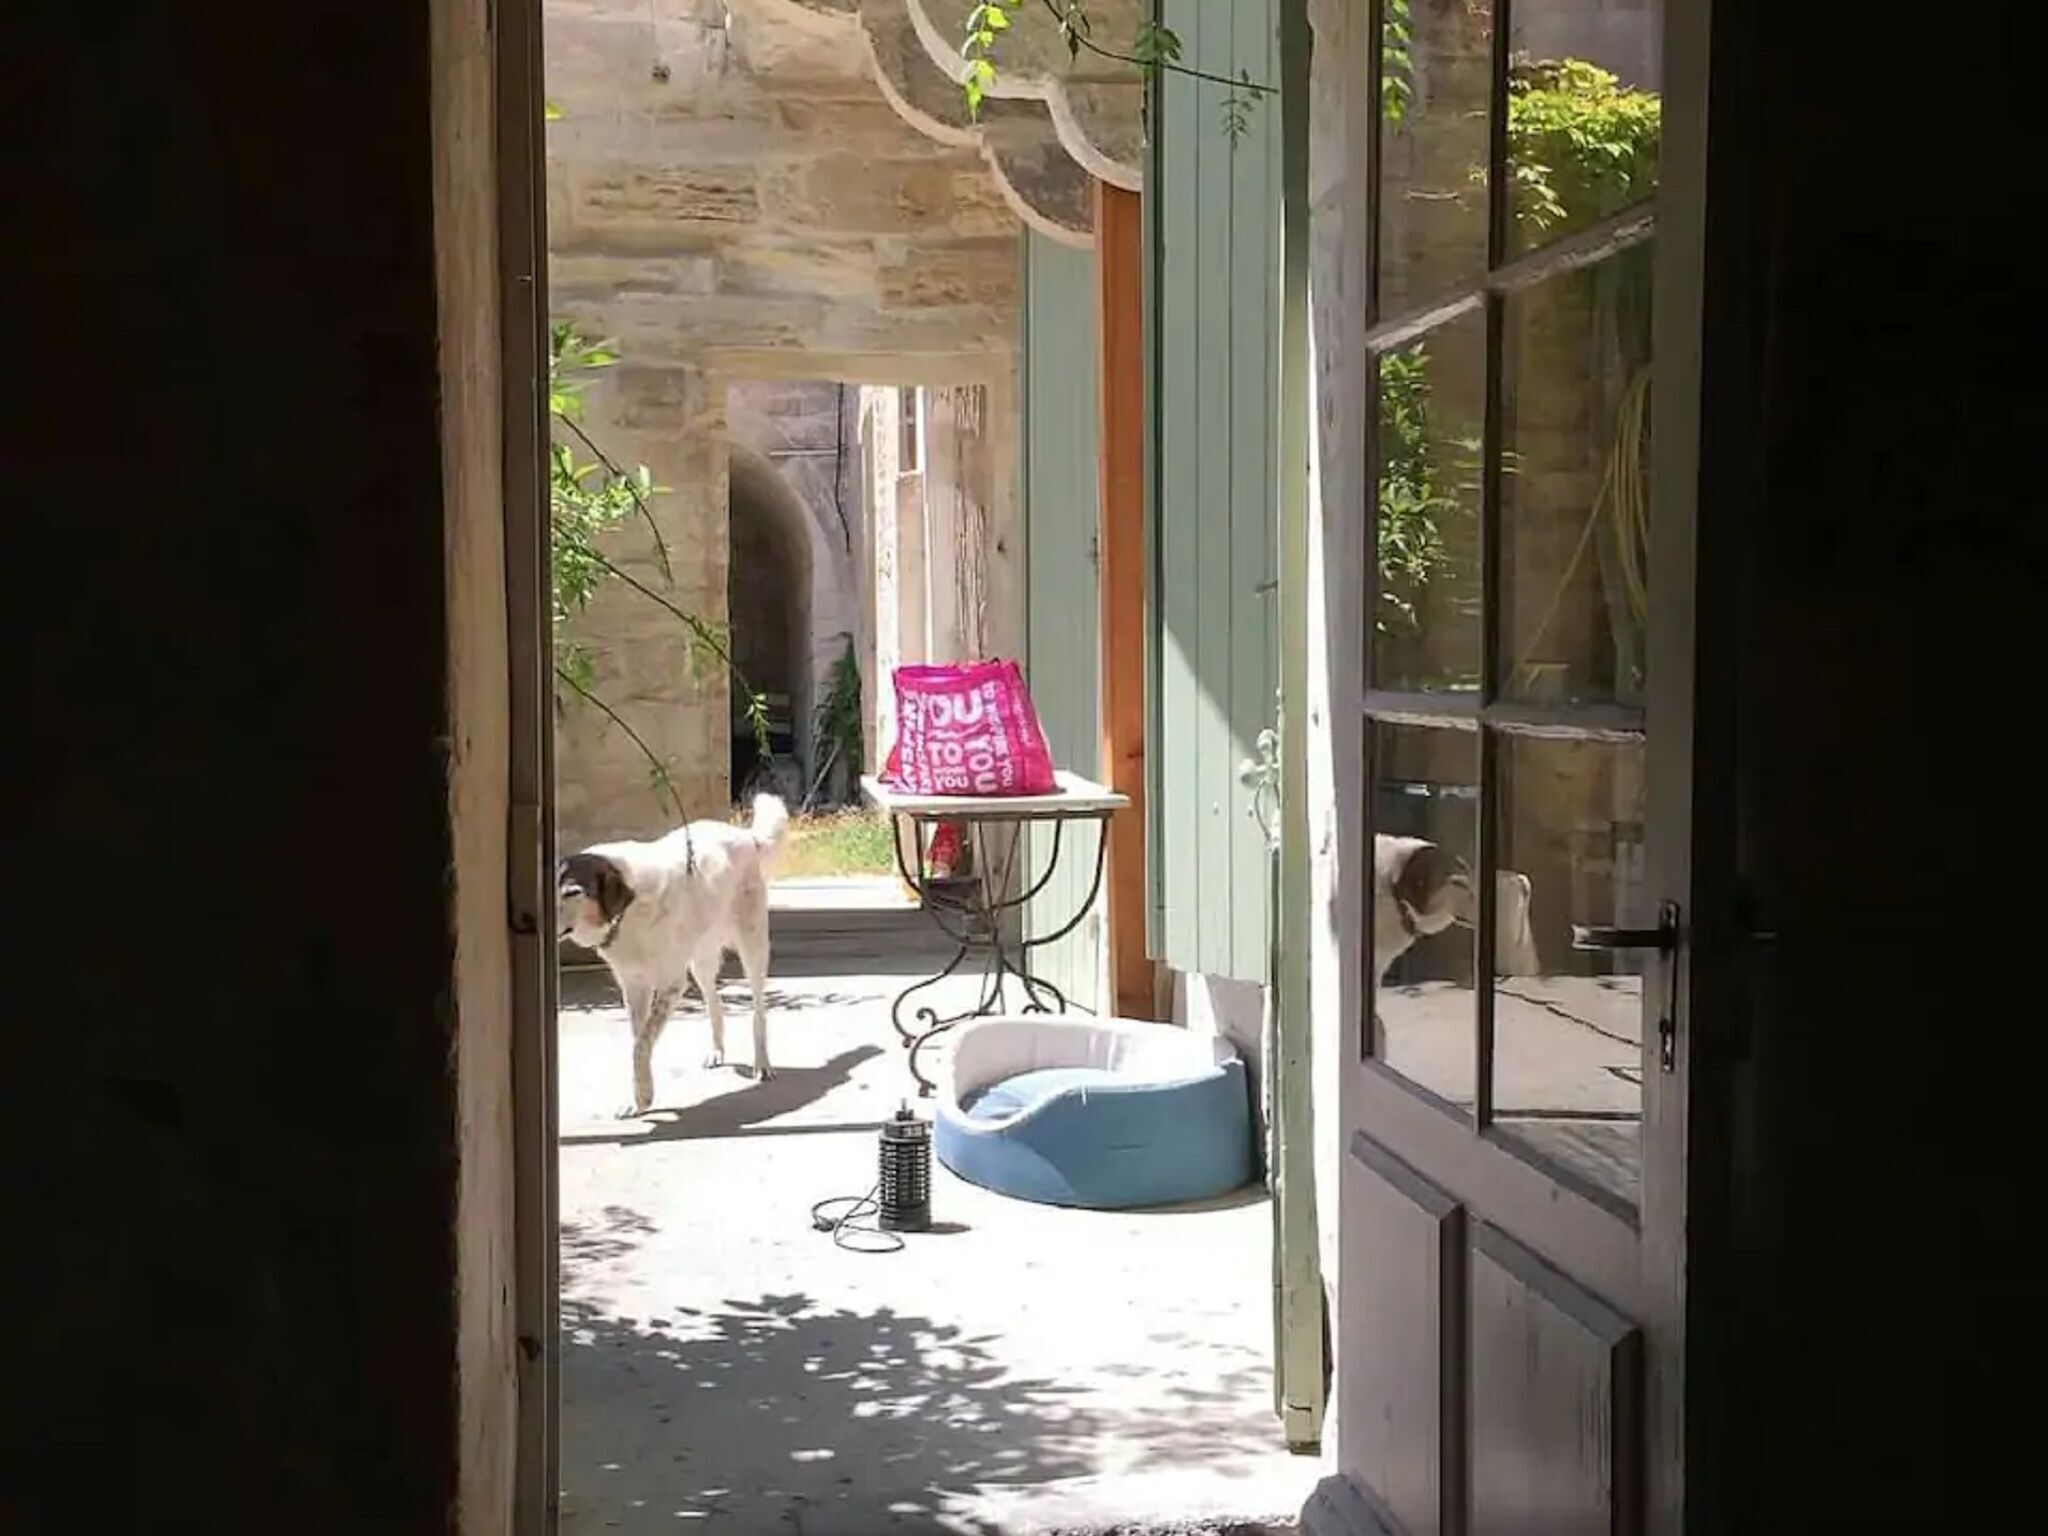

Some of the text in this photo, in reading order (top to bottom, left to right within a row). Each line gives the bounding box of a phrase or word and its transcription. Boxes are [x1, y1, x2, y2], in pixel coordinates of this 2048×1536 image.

[927, 742, 963, 766] TO
[964, 734, 999, 793] YOU
[932, 775, 969, 791] YOU
